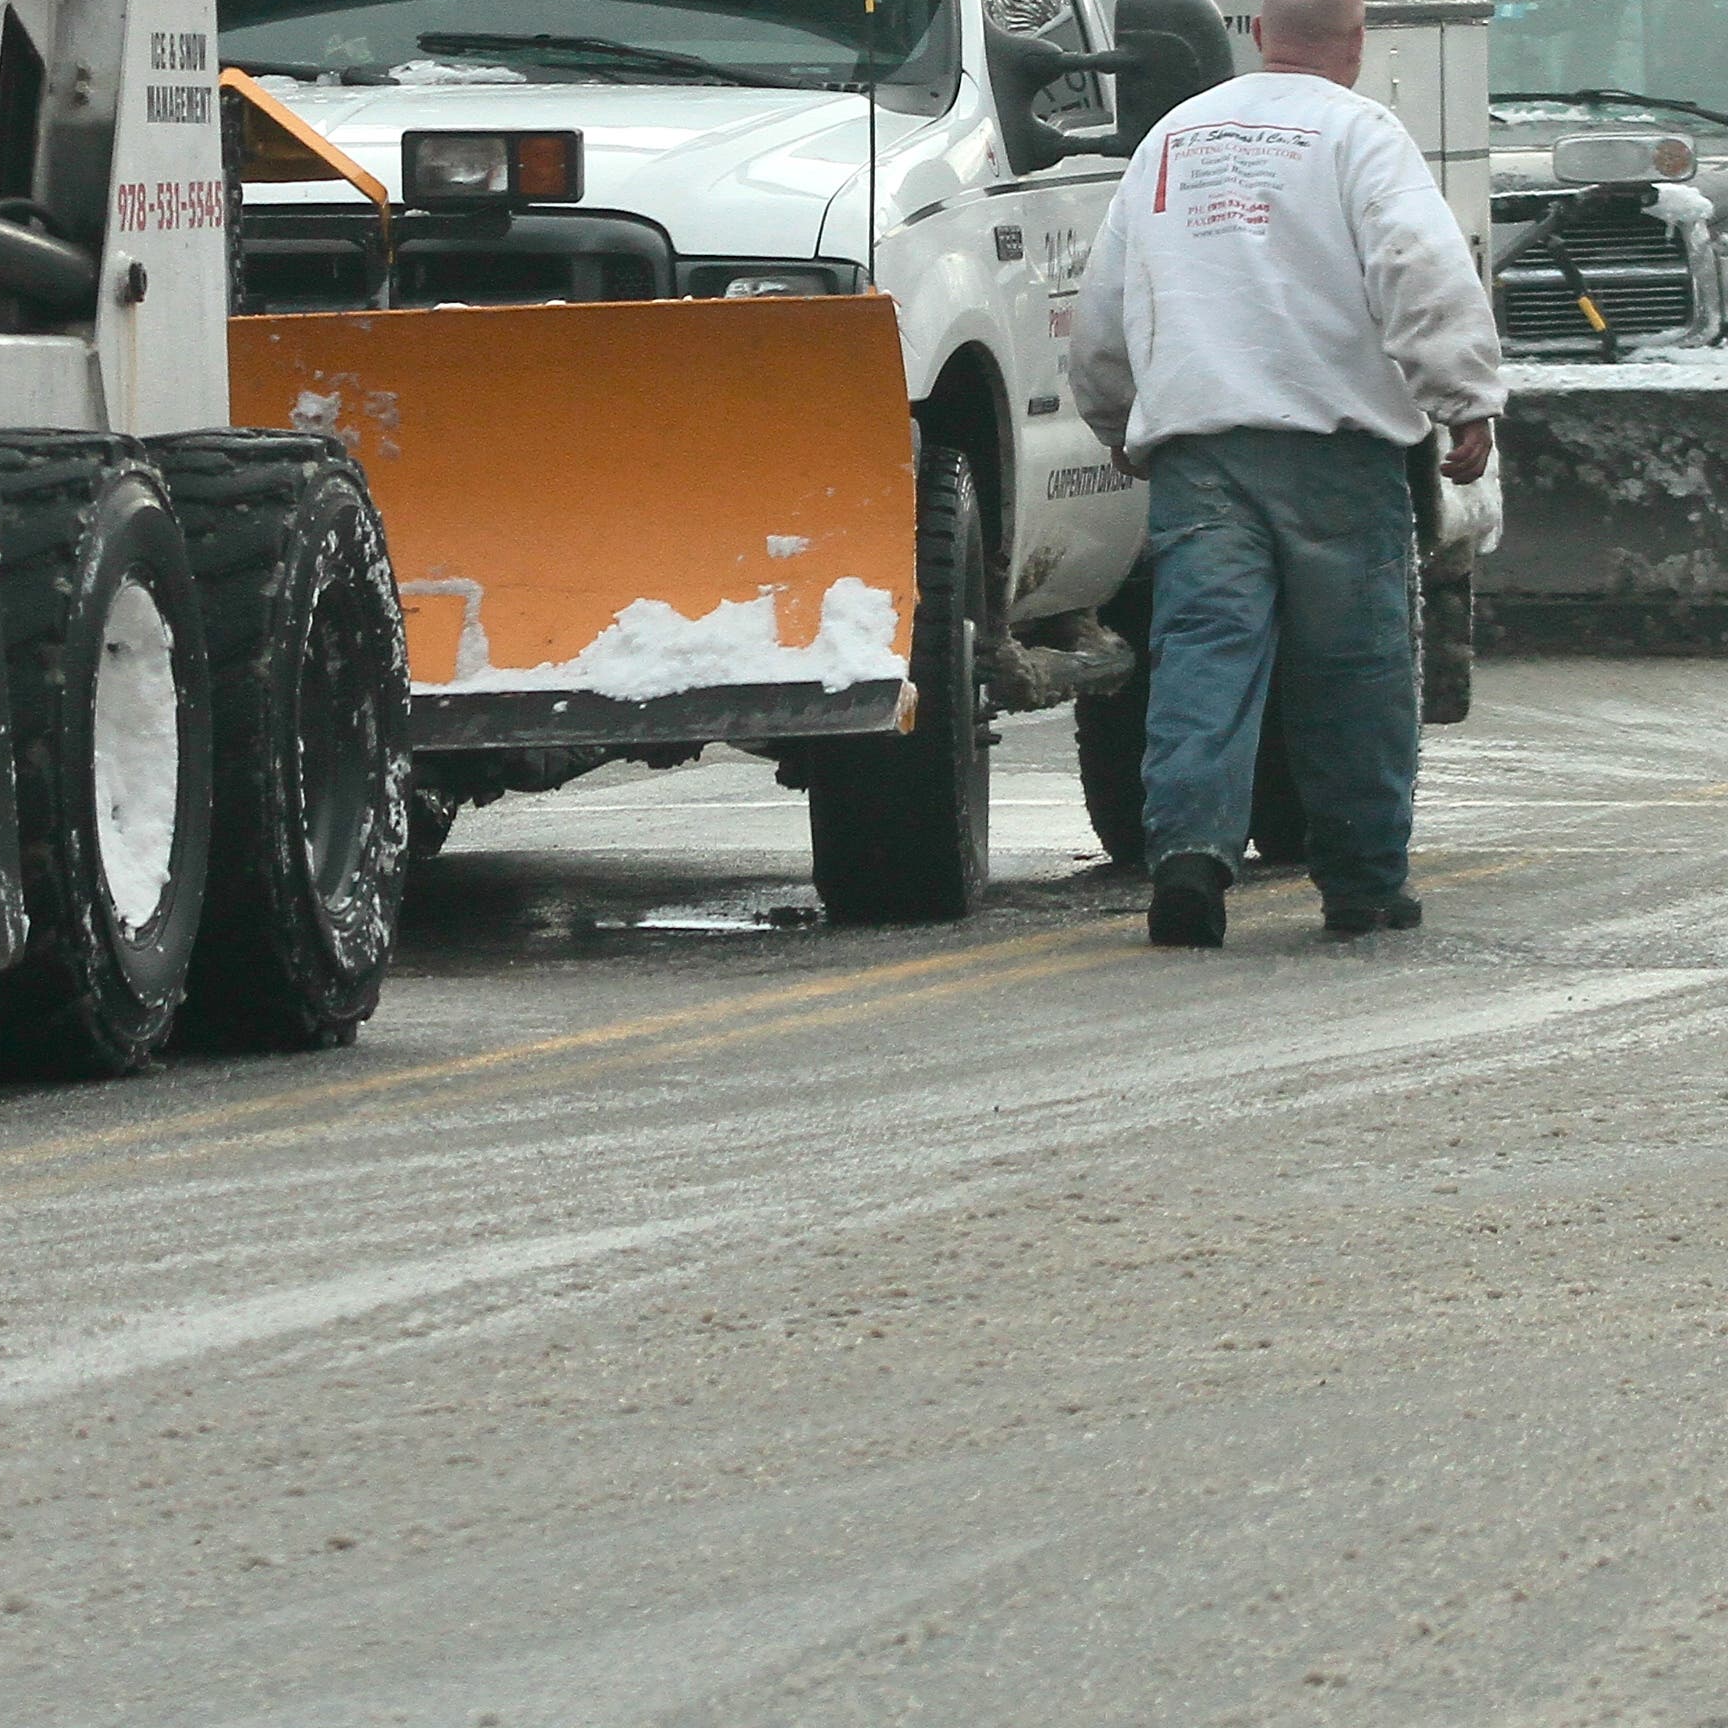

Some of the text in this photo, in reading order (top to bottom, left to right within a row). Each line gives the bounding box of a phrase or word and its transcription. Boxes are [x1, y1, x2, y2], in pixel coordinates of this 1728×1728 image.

[150, 32, 207, 71] ICE & SNOW
[146, 85, 212, 124] MANAGEMENT
[117, 180, 224, 232] 978-531-5545
